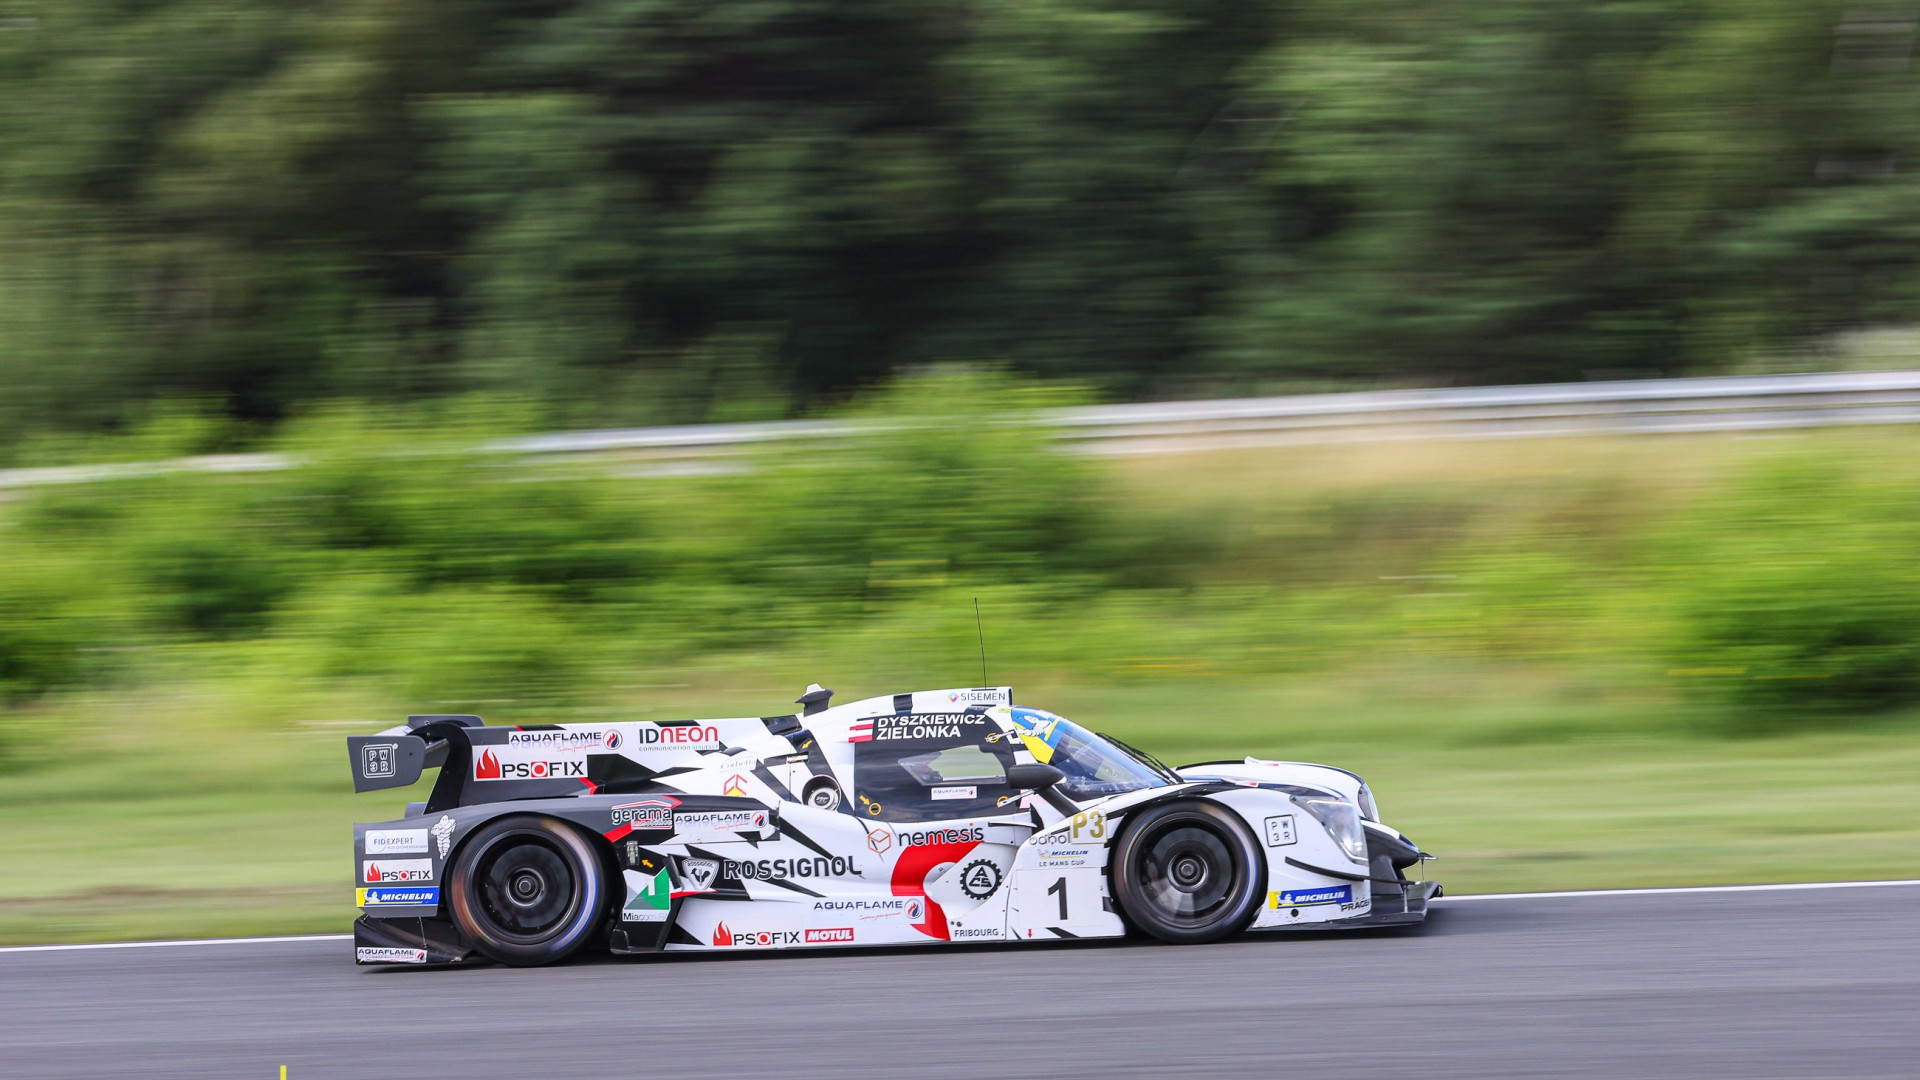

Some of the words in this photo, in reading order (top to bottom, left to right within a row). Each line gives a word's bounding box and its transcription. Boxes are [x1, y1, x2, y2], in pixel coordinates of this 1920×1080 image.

[960, 692, 1006, 701] SISEMEN
[877, 714, 986, 727] DYSZKIEWICZ
[510, 731, 602, 743] AQUAFLAME
[876, 725, 961, 741] ZIELONKA
[612, 808, 671, 825] gerama
[675, 813, 751, 823] AQUAFLAME
[1073, 810, 1105, 839] P3
[899, 823, 985, 847] nemesis
[724, 856, 865, 880] ROSSIGNOL
[381, 893, 434, 901] MICHELIN
[1048, 877, 1068, 920] 1
[1295, 891, 1345, 903] MICHELIN
[814, 901, 903, 910] AQUAFLAME
[807, 930, 852, 941] MOTUL
[954, 929, 999, 938] FRIBOURG
[358, 949, 415, 957] AQUAFLAME
